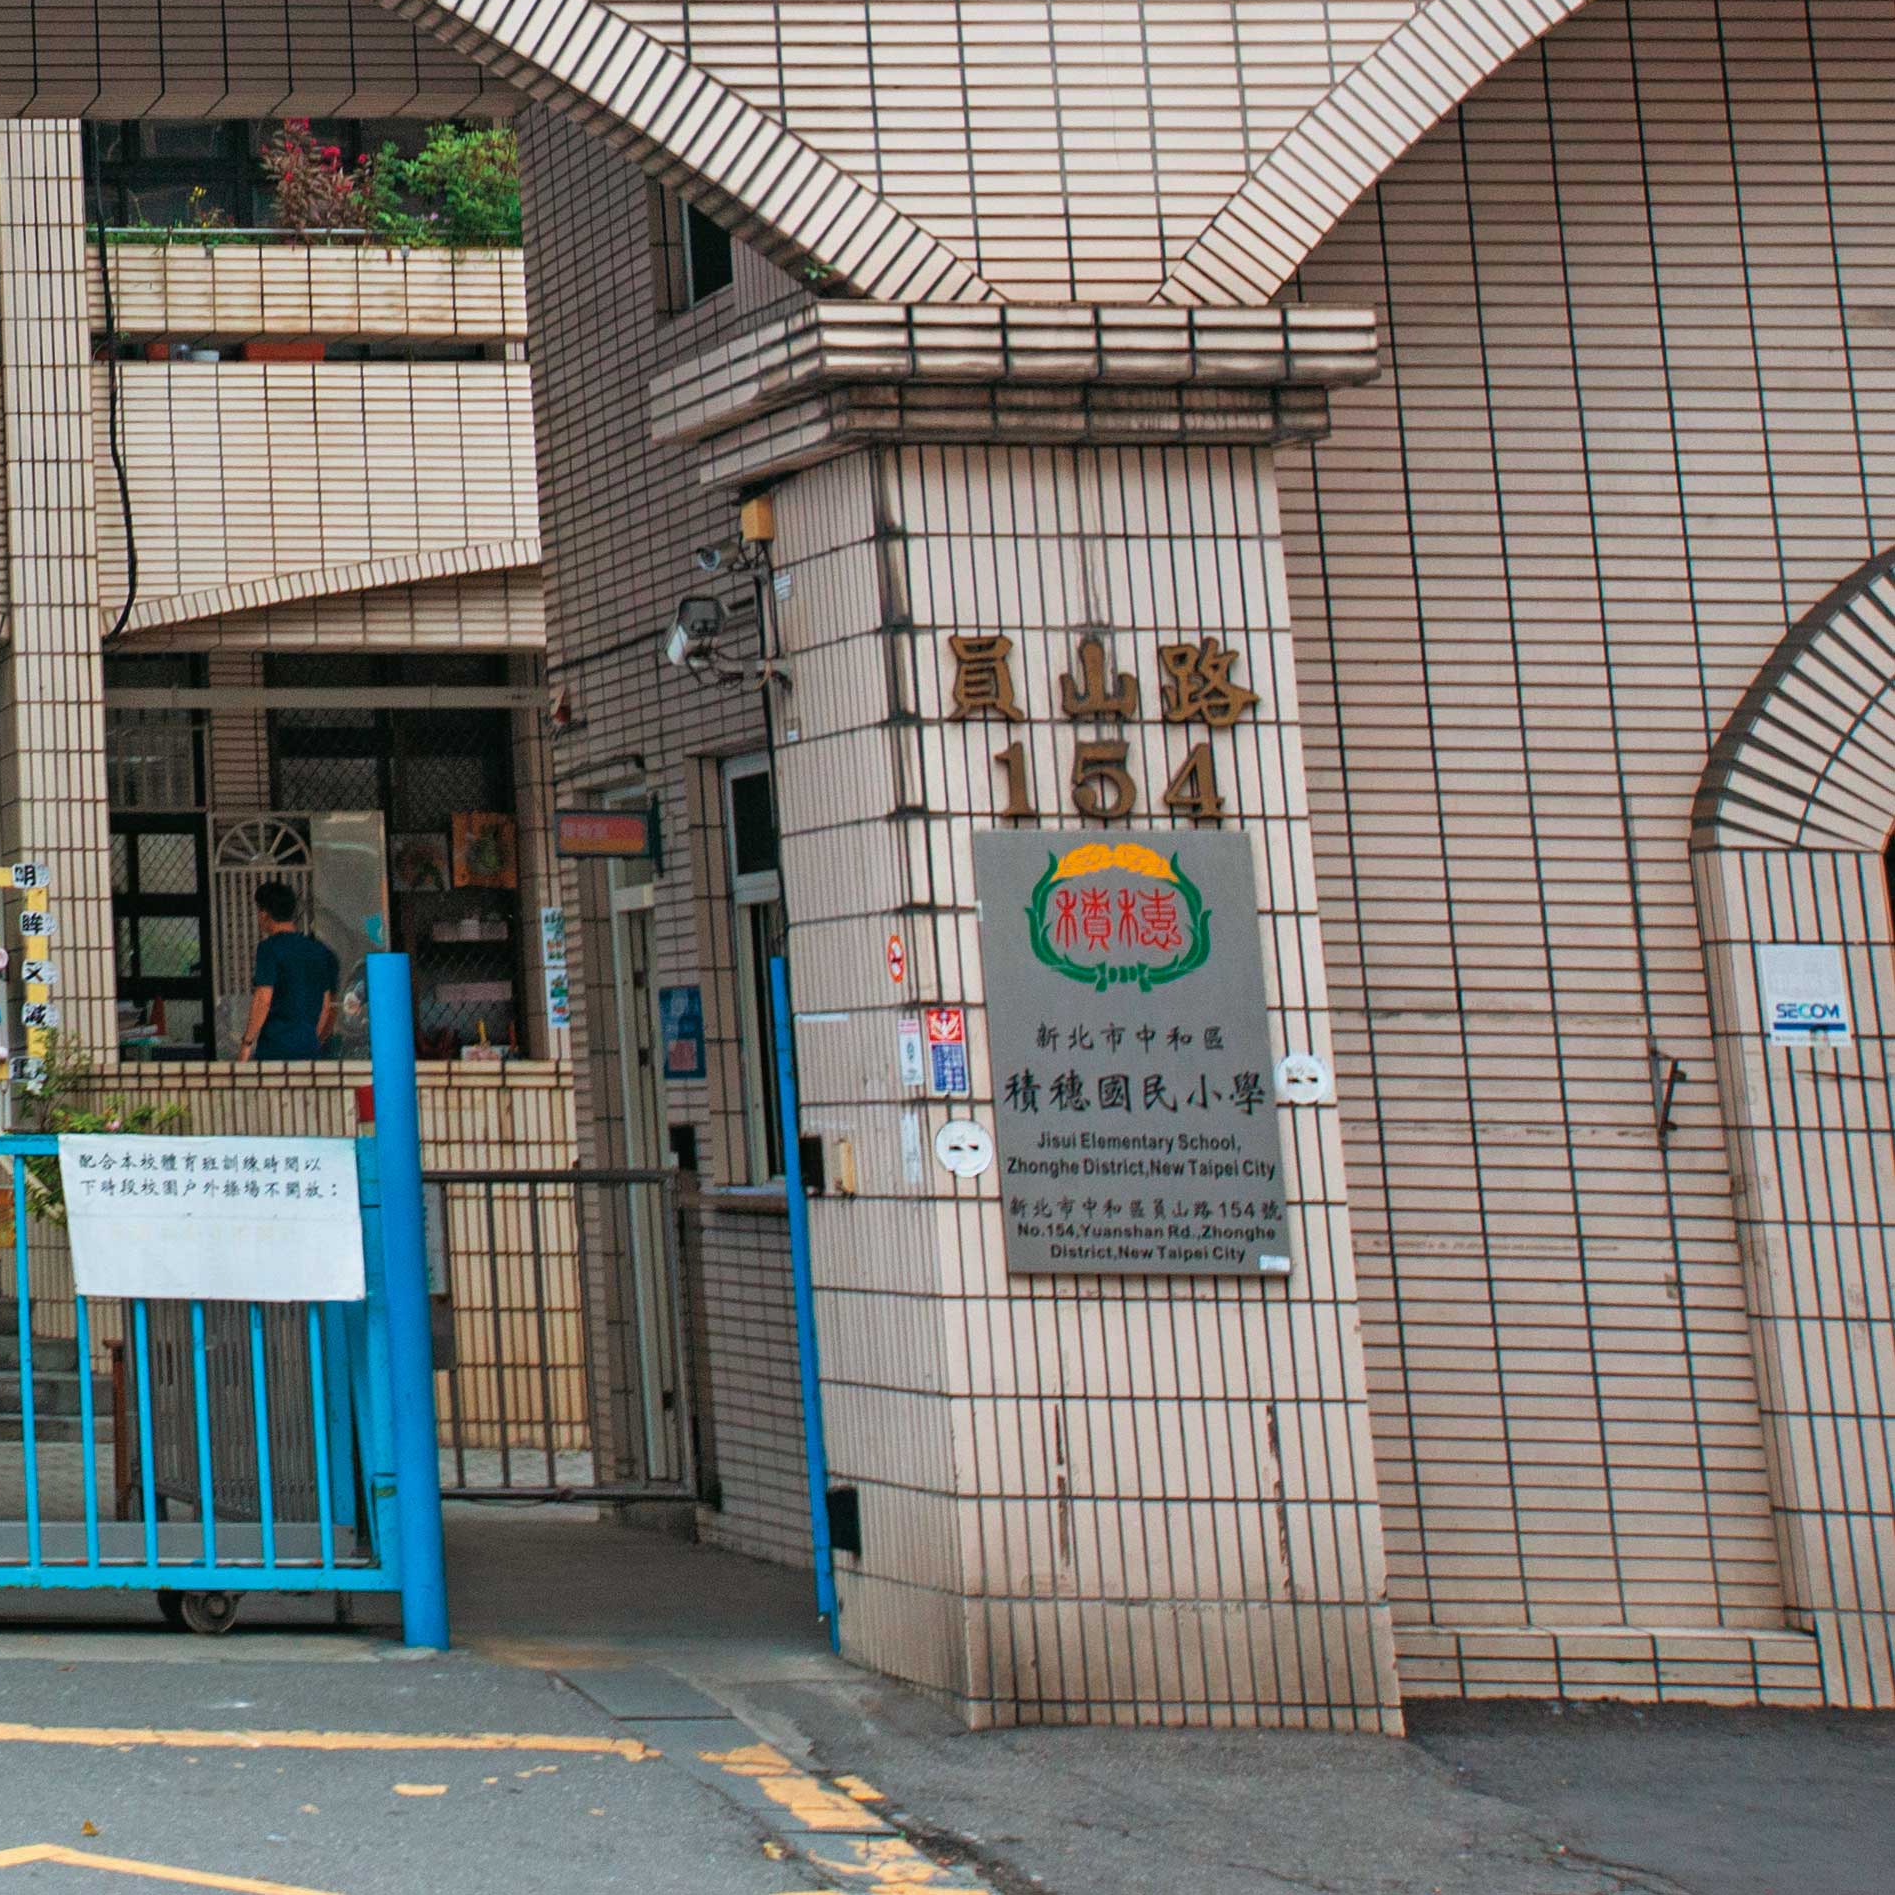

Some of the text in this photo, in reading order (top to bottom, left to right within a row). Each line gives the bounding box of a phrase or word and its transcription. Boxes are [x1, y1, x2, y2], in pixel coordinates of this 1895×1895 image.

[948, 635, 1259, 728] 員山路
[995, 740, 1225, 819] 154
[1775, 1003, 1841, 1019] SECOM
[1035, 1022, 1225, 1052] 新北市中和區
[1004, 1068, 1266, 1115] 積穗國民小學
[1037, 1132, 1242, 1155] Jisui Elementary School,
[78, 1153, 322, 1173] 配合本校體育班訓練時間以
[1007, 1157, 1079, 1179] Zhonghe
[1189, 1159, 1239, 1180] Taipei
[1242, 1159, 1276, 1181] City
[1157, 1246, 1209, 1263] Taipei
[1211, 1246, 1247, 1264] City
